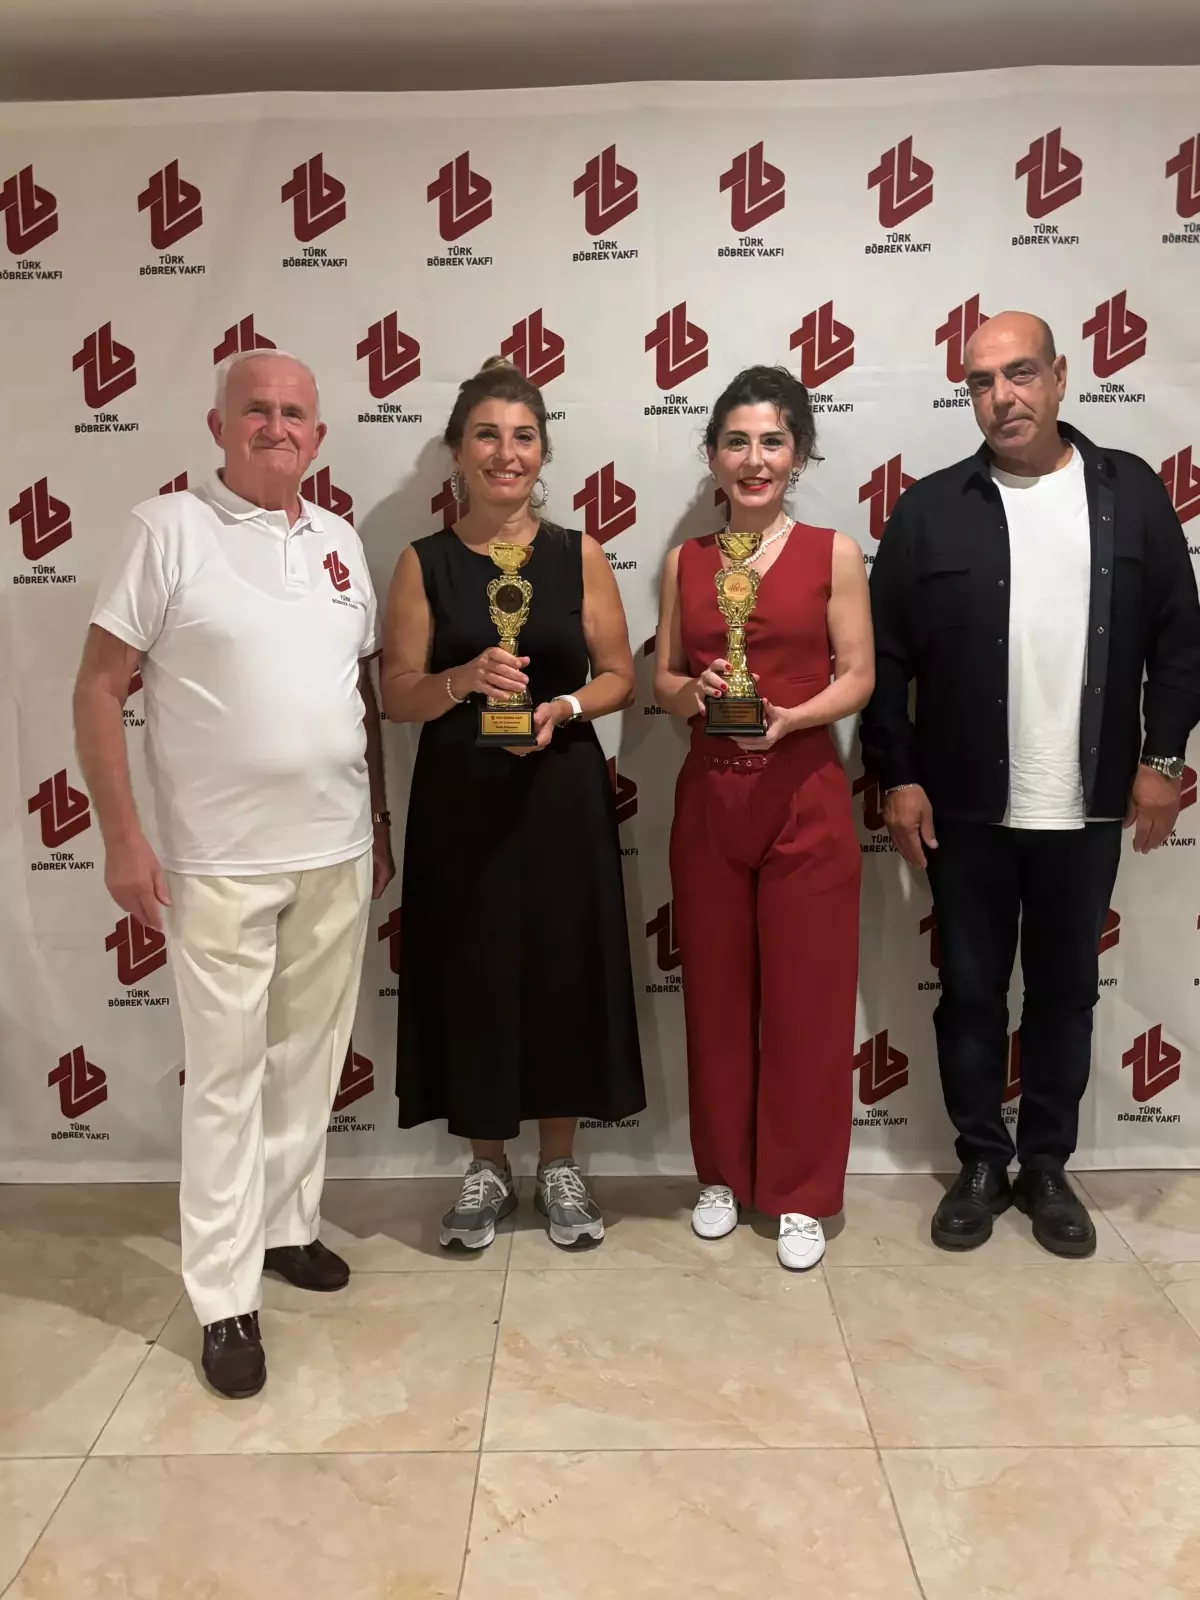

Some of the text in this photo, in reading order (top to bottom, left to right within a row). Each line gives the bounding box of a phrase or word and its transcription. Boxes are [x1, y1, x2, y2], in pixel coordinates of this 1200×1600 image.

[1033, 223, 1059, 234] TÜRK
[1184, 223, 1200, 233] TÜR
[738, 237, 763, 247] TÜRK
[886, 232, 911, 243] TÜRK
[1011, 234, 1079, 246] BÖBREK VAKFI
[1161, 233, 1200, 244] BÖBREK
[593, 240, 618, 250] TÜRK
[864, 243, 931, 254] BÖBREK VAKFI
[302, 247, 328, 257] TÜRK
[447, 246, 473, 256] TÜRK
[572, 249, 638, 262] BÖBREK VAKFI
[717, 247, 784, 257] BÖBREK VAKFI
[159, 254, 184, 265] TÜRK
[282, 257, 348, 268] BÖBREK VAKFI
[427, 256, 493, 267] BÖBREK VAKFI
[16, 260, 41, 270] TÜRK
[35, 271, 62, 280] VAKFI
[139, 265, 206, 276] BÖBREK VAKFI
[953, 387, 971, 398] TÜR
[1100, 383, 1126, 393] TÜRK
[663, 395, 688, 405] TÜRK
[809, 394, 833, 404] TÜRK
[1079, 393, 1146, 404] BÖBREK VAKFI
[377, 403, 402, 413] TÜRK
[828, 404, 853, 413] VAKFI
[932, 399, 971, 409] BÖBREK
[643, 405, 708, 416] BÖBREK VAKFI
[93, 413, 119, 423] TÜRK
[357, 413, 422, 423] BÖBREK VAKFI
[545, 411, 566, 421] AKFI
[74, 422, 139, 433] BÖBREK VAKFI
[604, 552, 617, 561] RK
[32, 565, 56, 575] TÜRK
[612, 561, 637, 570] VAKFI
[13, 574, 77, 585] BÖBREK VAKFI
[129, 718, 145, 727] VAK
[1170, 838, 1196, 846] VAKFI
[619, 848, 638, 856] AKFI
[860, 844, 887, 853] BREK
[50, 853, 74, 863] TÜRK
[31, 862, 94, 871] BÖBREK VAKFI
[665, 975, 682, 985] TÜR
[1098, 978, 1118, 987] AKFI
[645, 984, 680, 994] BÖBREK
[918, 981, 941, 991] BÖBR
[127, 989, 150, 998] TÜRK
[108, 998, 170, 1007] BÖBREK VAKFI
[866, 1109, 889, 1118] TÜRK
[1001, 1105, 1018, 1115] TÜR
[1138, 1106, 1162, 1115] TÜRK
[334, 1115, 356, 1124] TÜRK
[852, 1118, 908, 1127] ÖBREK VAKFI
[1117, 1114, 1181, 1123] BÖBREK VAKFI
[70, 1122, 90, 1132] TÜRK
[327, 1124, 376, 1133] BREK VAKFI
[51, 1131, 110, 1141] BÖBREK VAKFI
